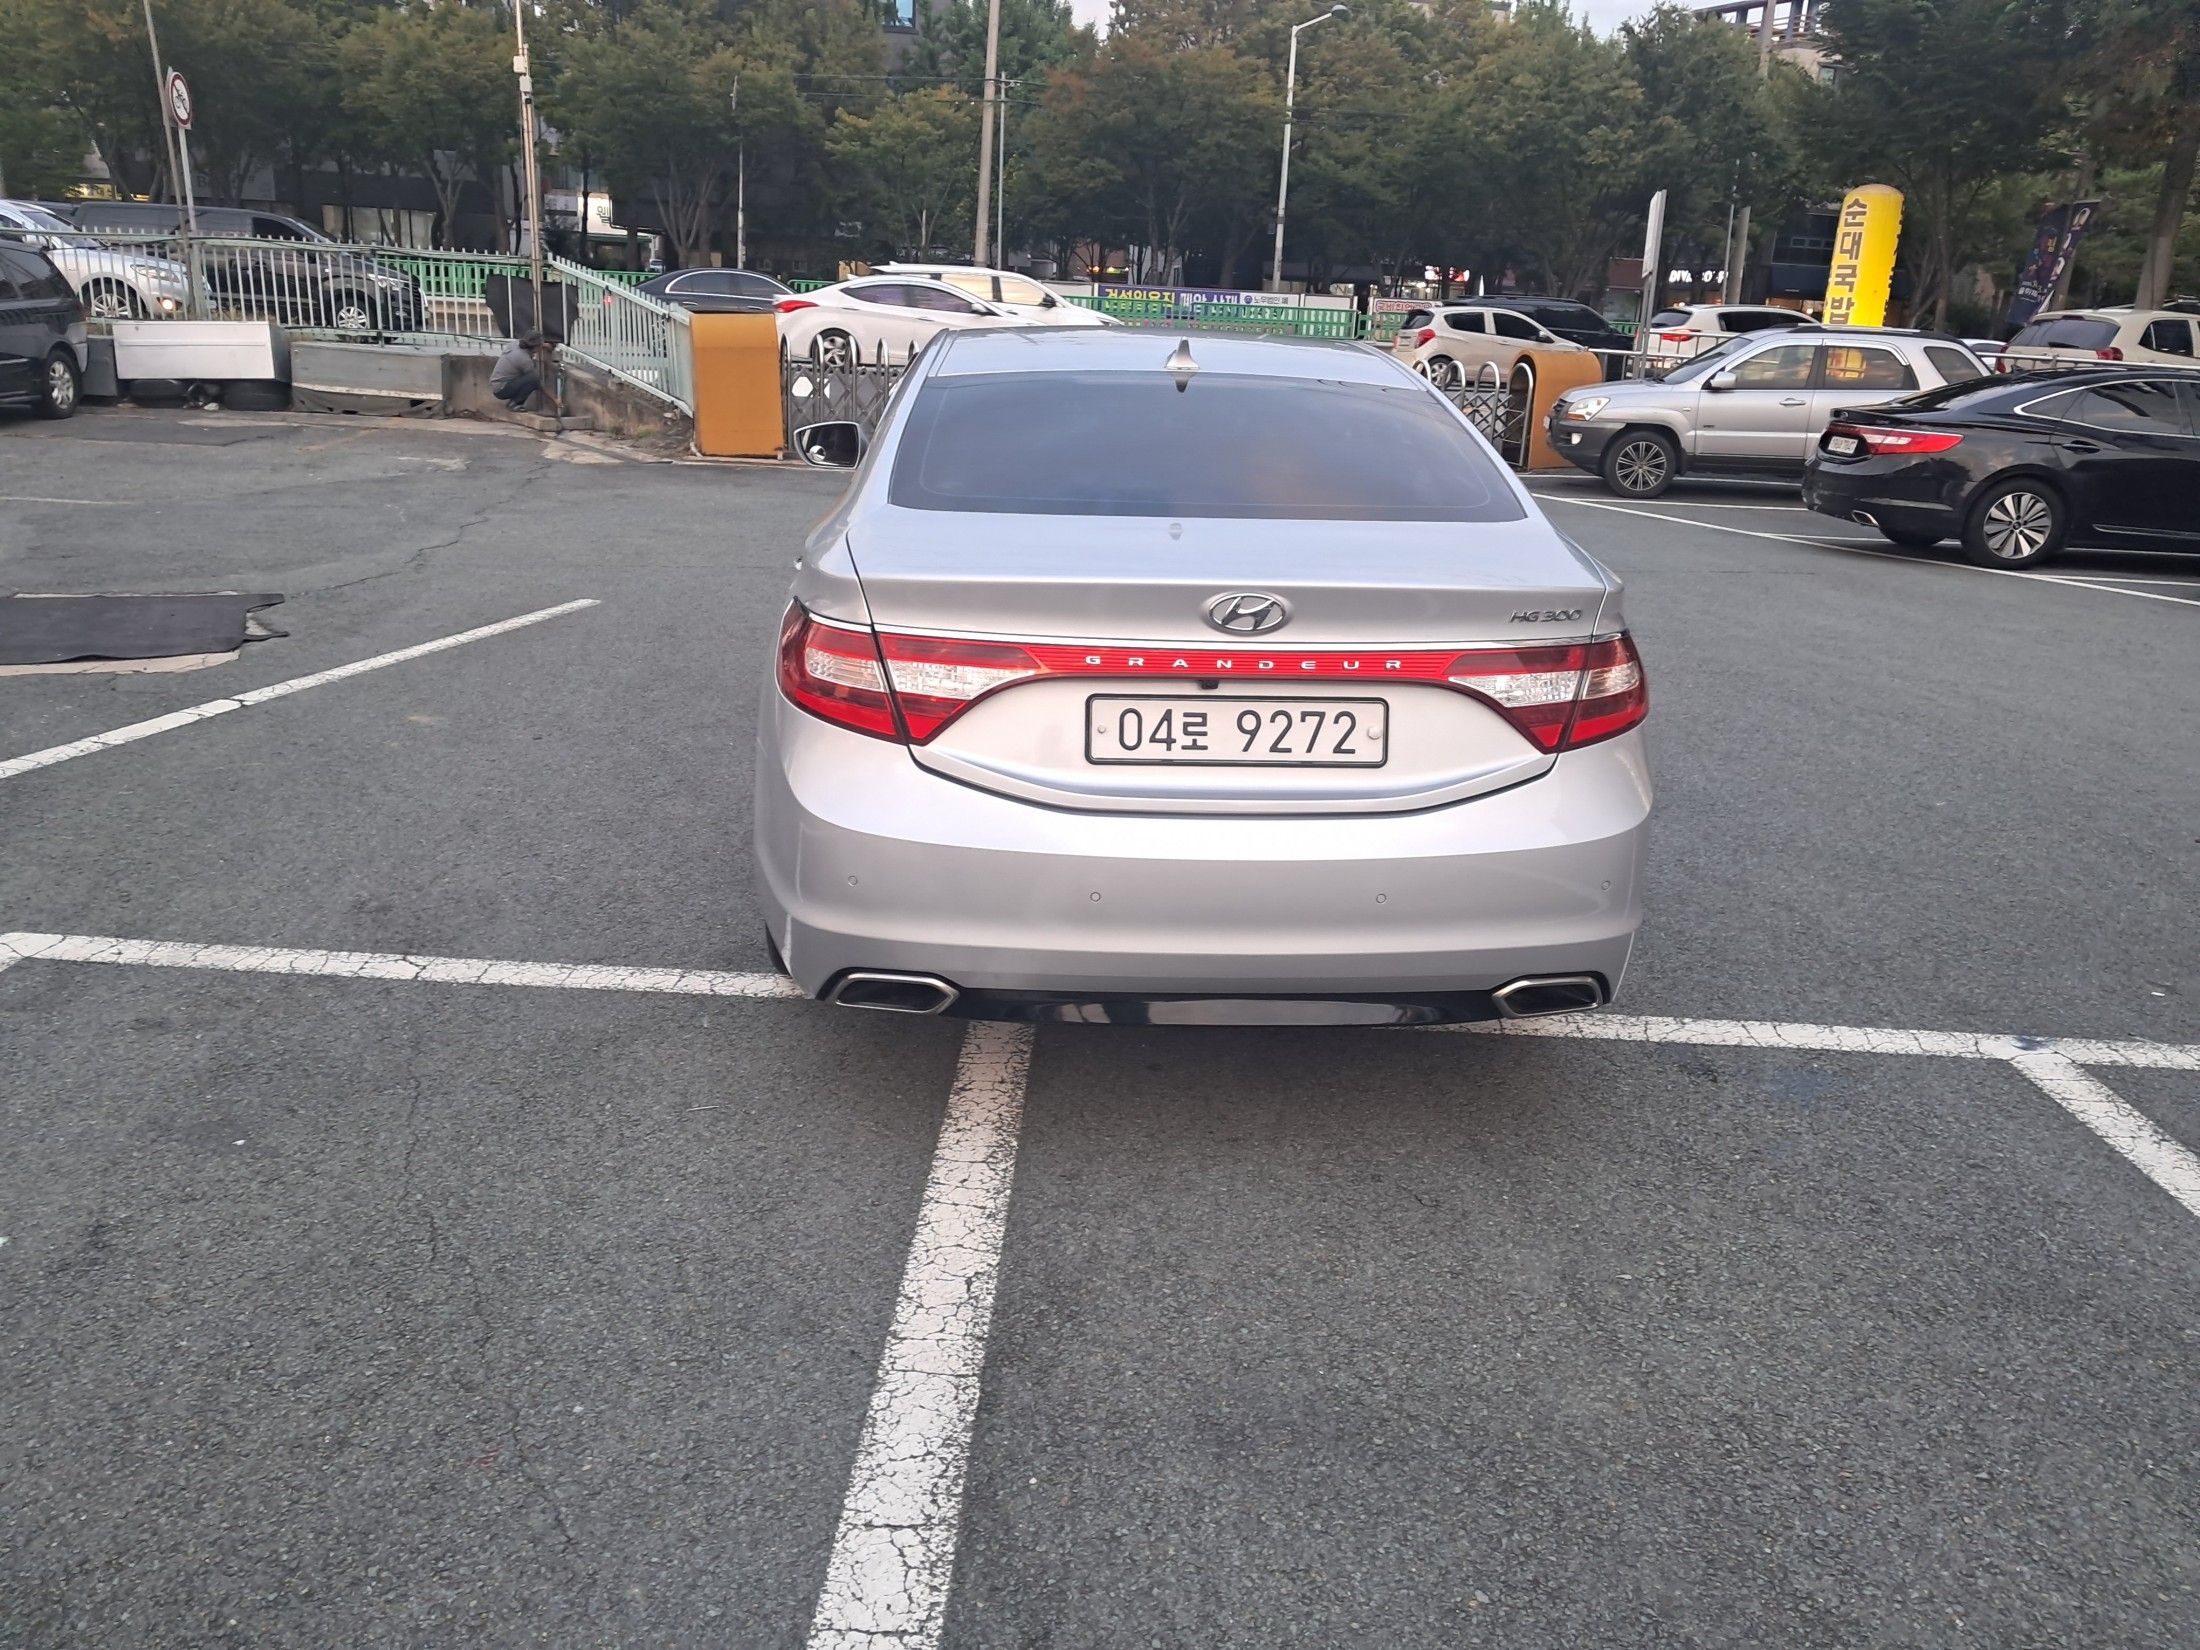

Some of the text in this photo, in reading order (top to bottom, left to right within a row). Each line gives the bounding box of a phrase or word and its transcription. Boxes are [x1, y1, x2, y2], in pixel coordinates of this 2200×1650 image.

[1829, 198, 1867, 325] 순대국밥
[1085, 655, 1401, 670] GRANDEUR
[1119, 707, 1357, 754] 04로 9272
